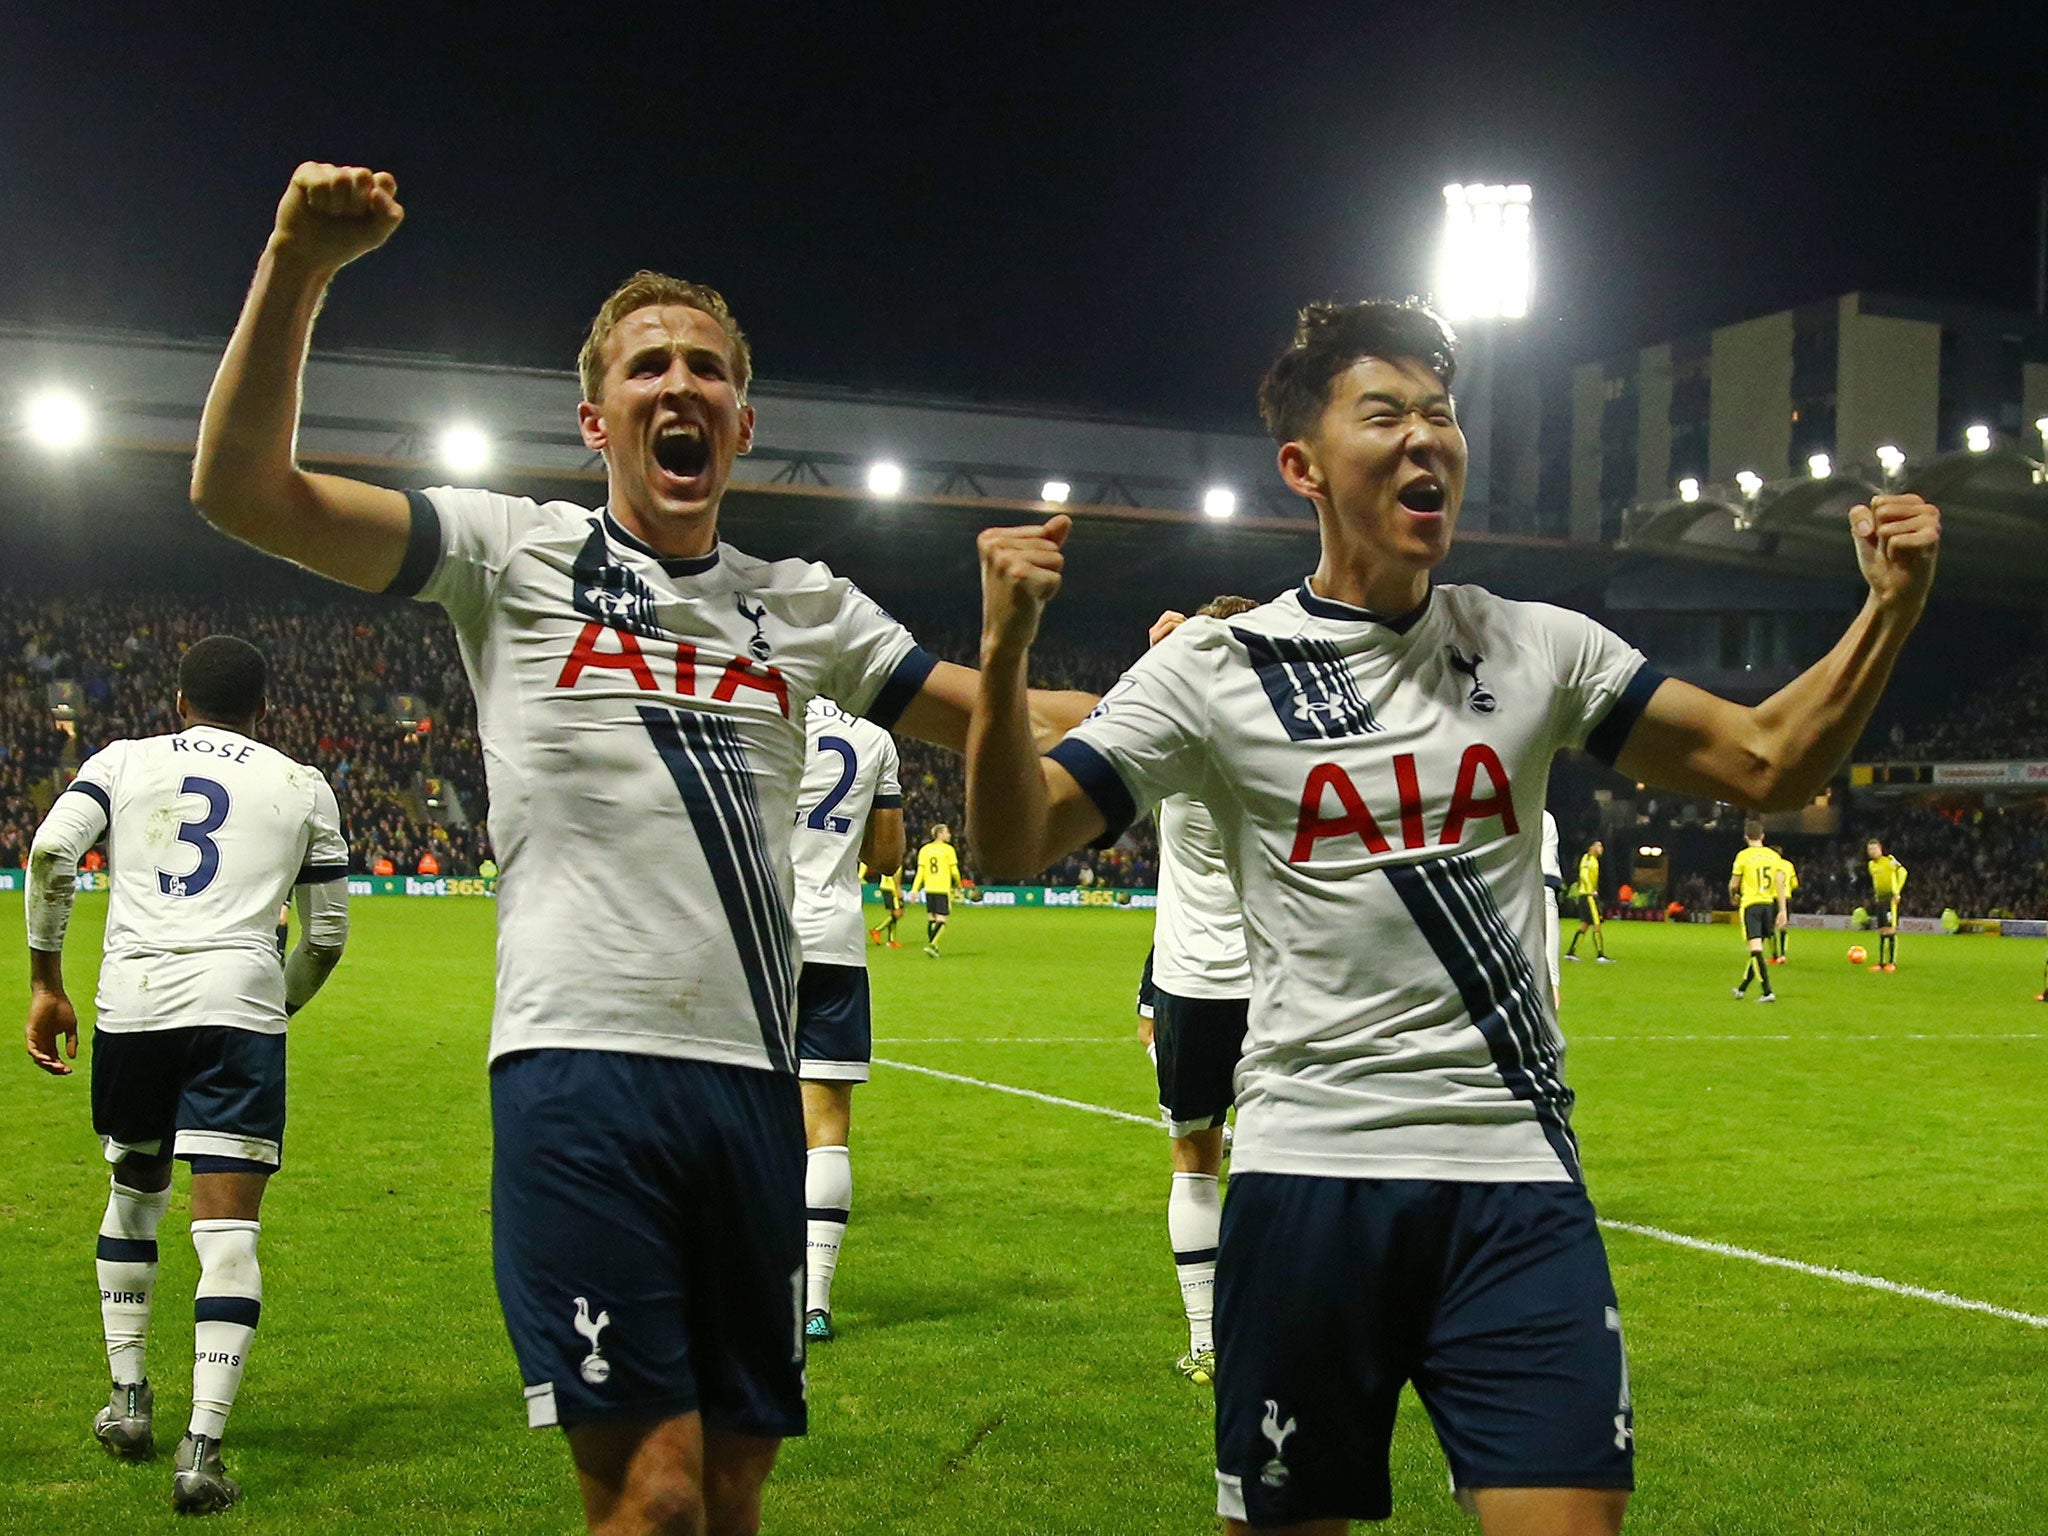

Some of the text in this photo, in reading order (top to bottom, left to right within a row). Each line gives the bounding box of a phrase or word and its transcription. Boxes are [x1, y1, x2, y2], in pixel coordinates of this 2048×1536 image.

[555, 620, 790, 719] AIA
[171, 737, 255, 765] ROSE
[1288, 742, 1520, 864] AIA
[154, 774, 234, 898] 3
[929, 855, 940, 875] 8
[1755, 866, 1772, 890] 15
